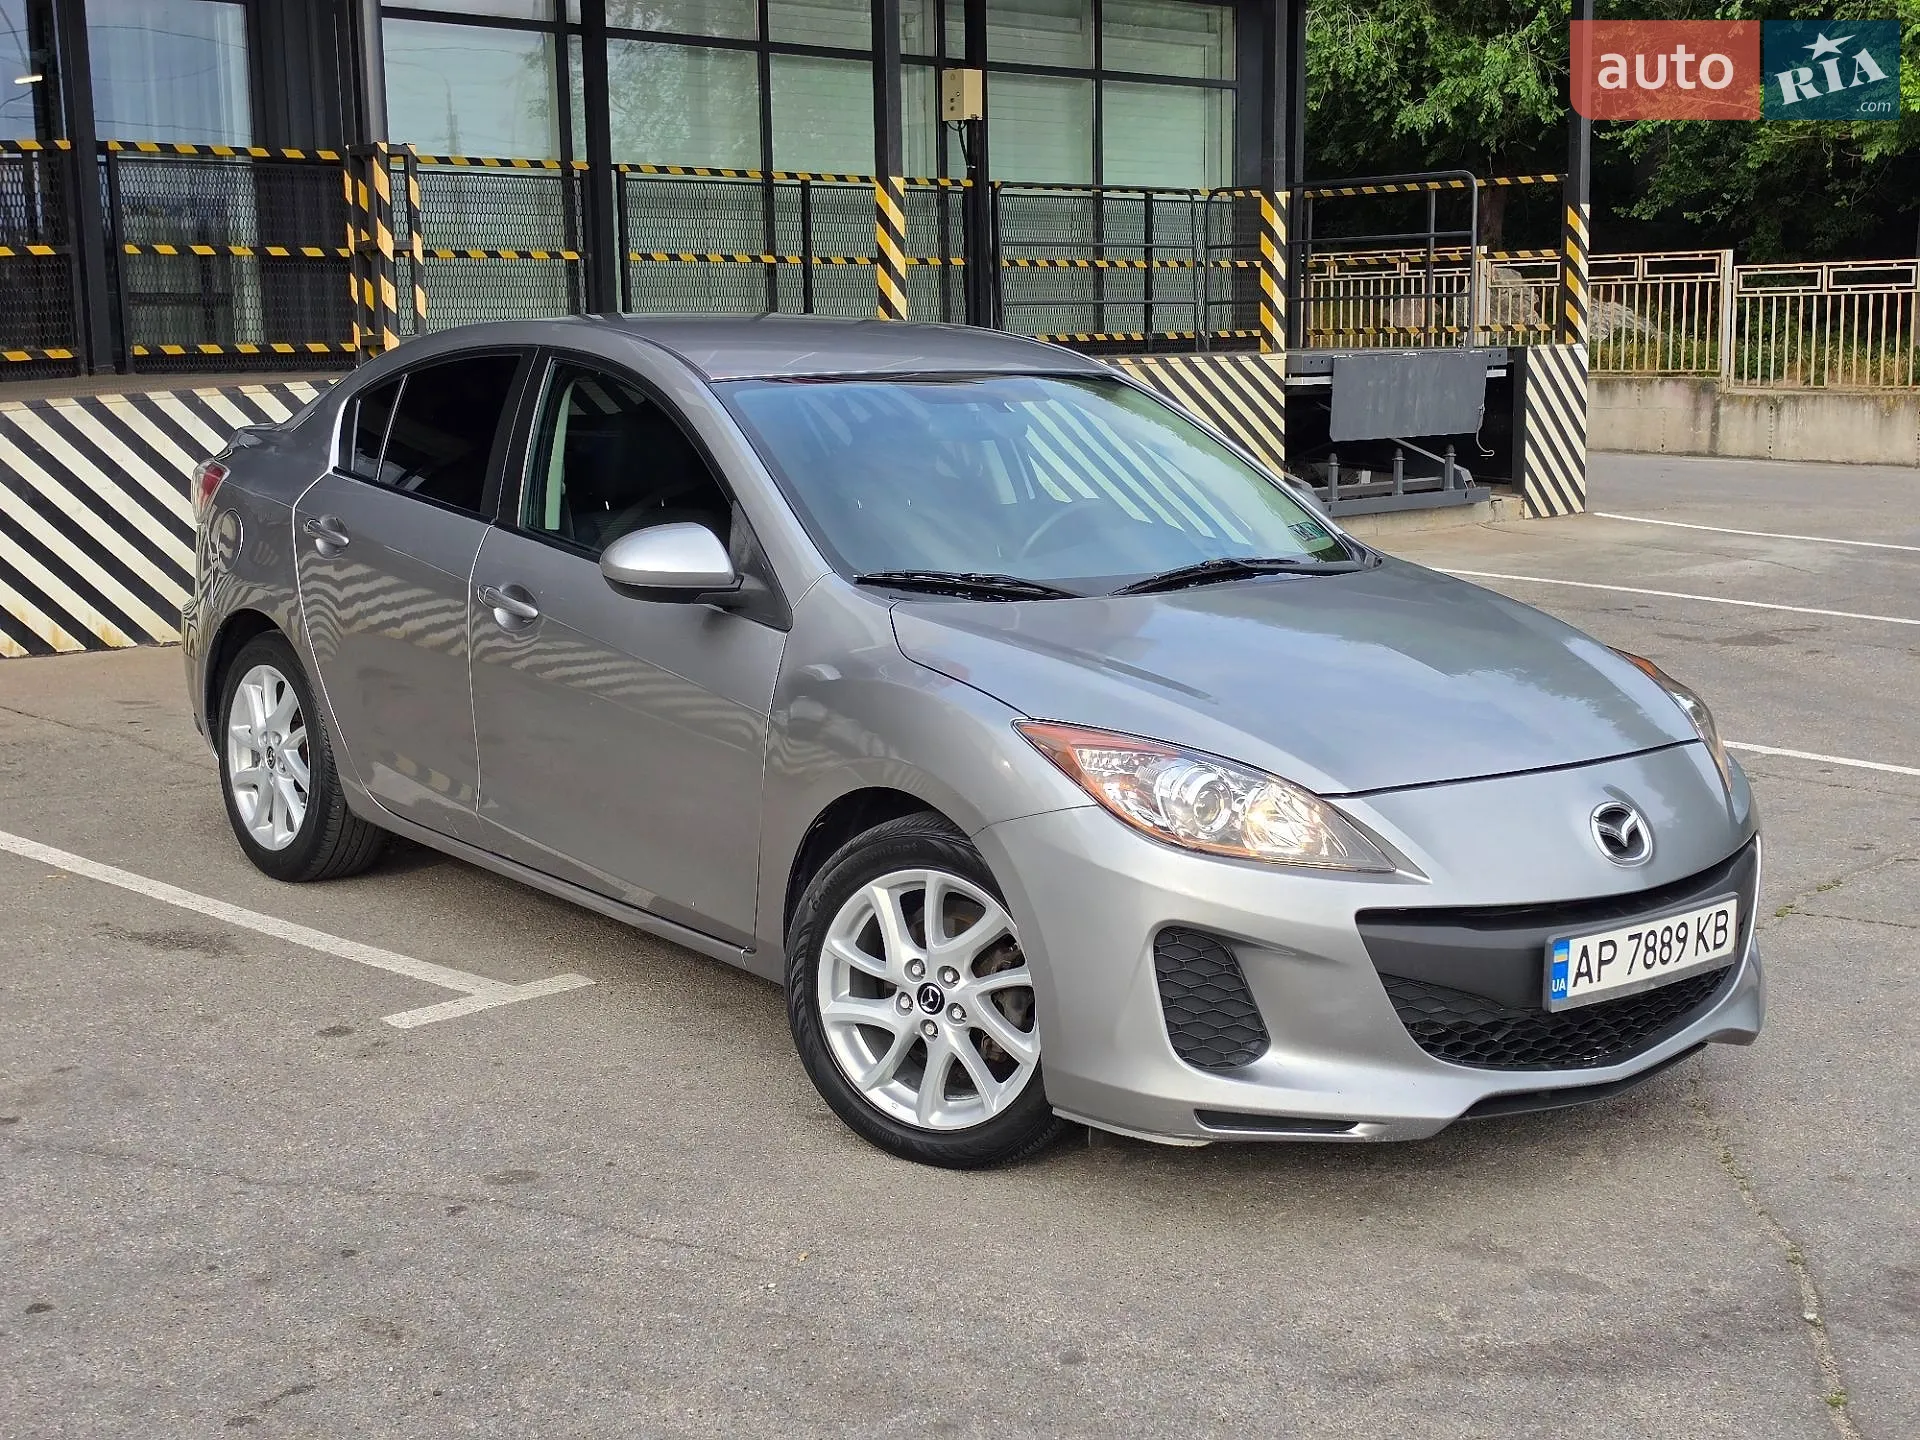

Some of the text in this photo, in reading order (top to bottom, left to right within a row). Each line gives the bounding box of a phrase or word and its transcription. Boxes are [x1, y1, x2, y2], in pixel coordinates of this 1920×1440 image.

[1572, 909, 1729, 988] AP 7889 KB
[1551, 977, 1566, 993] UA
